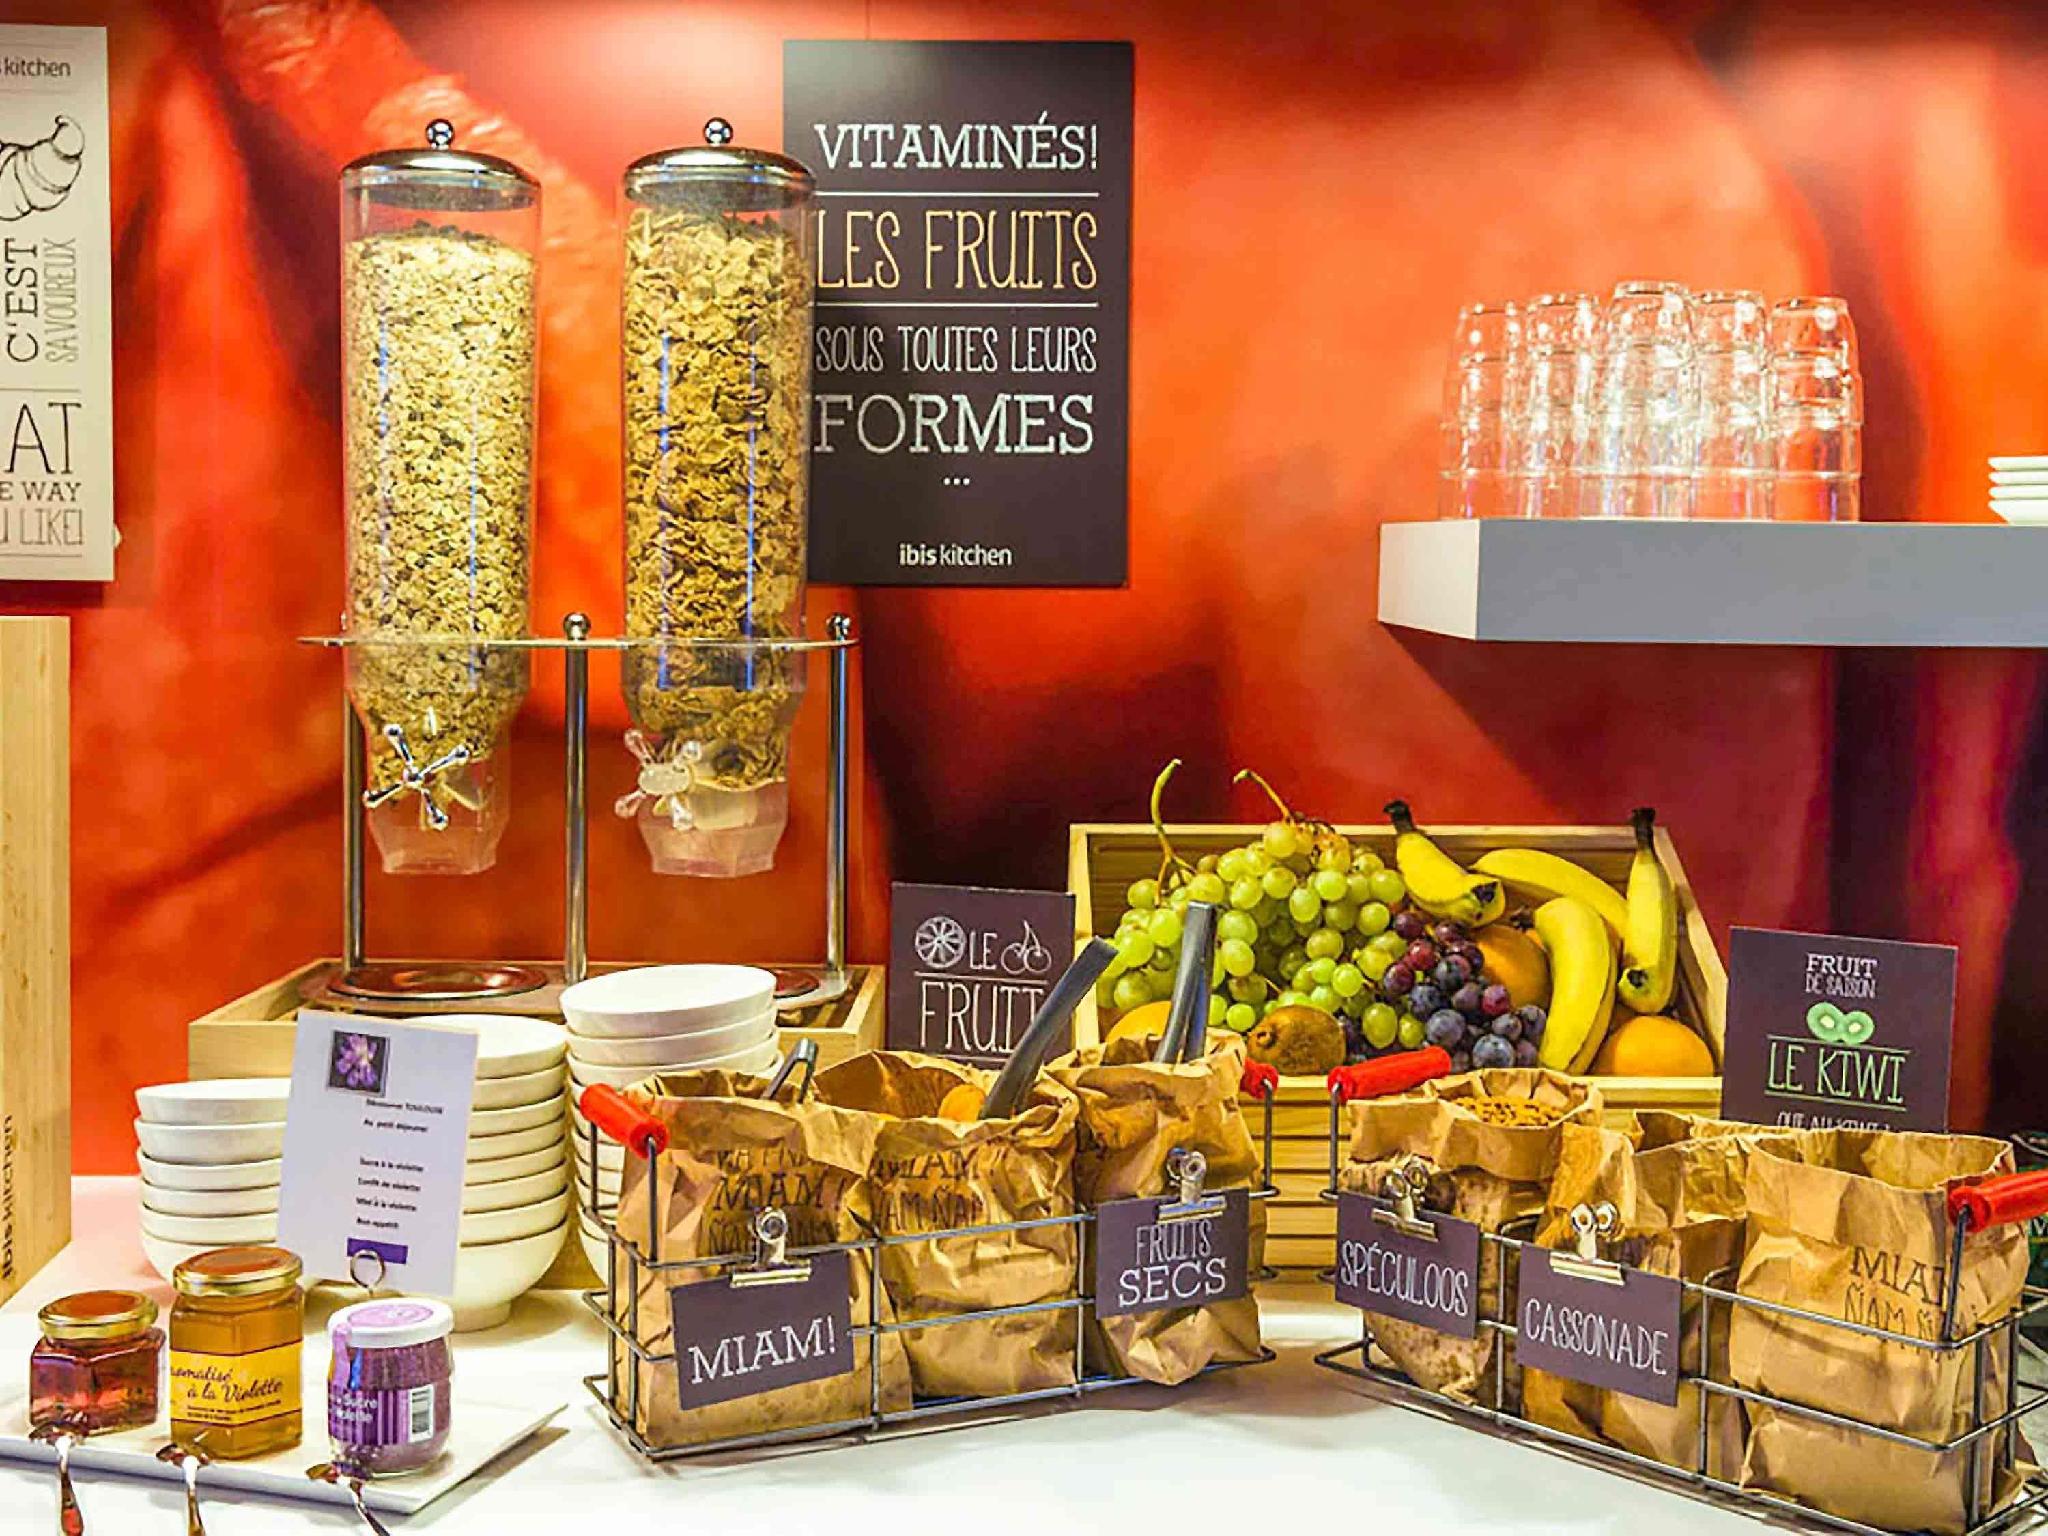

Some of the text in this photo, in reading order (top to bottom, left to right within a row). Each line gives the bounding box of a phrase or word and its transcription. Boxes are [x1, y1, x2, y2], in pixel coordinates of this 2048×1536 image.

[4, 57, 71, 77] kitchen
[814, 110, 1098, 169] VITAMINÉS!
[815, 209, 1098, 290] LES FRUITS
[4, 237, 39, 362] C'EST
[43, 237, 79, 363] SAVOUREUX
[815, 325, 1098, 373] SOUS TOUTES LEURS
[812, 393, 1094, 455] FORMES
[22, 481, 81, 501] WAY
[899, 543, 1013, 566] ibis kitchen
[969, 931, 998, 970] LE
[1806, 953, 1878, 978] FRUIT
[1805, 972, 1877, 998] DE SAISON
[1768, 1042, 1906, 1104] LE KIWI
[1136, 1219, 1213, 1265] FRUITS
[1118, 1257, 1227, 1307] SECS
[1340, 1239, 1469, 1317] SPÉCULOOS
[689, 1314, 836, 1385] MIAM!
[1524, 1298, 1669, 1376] CASSONADE
